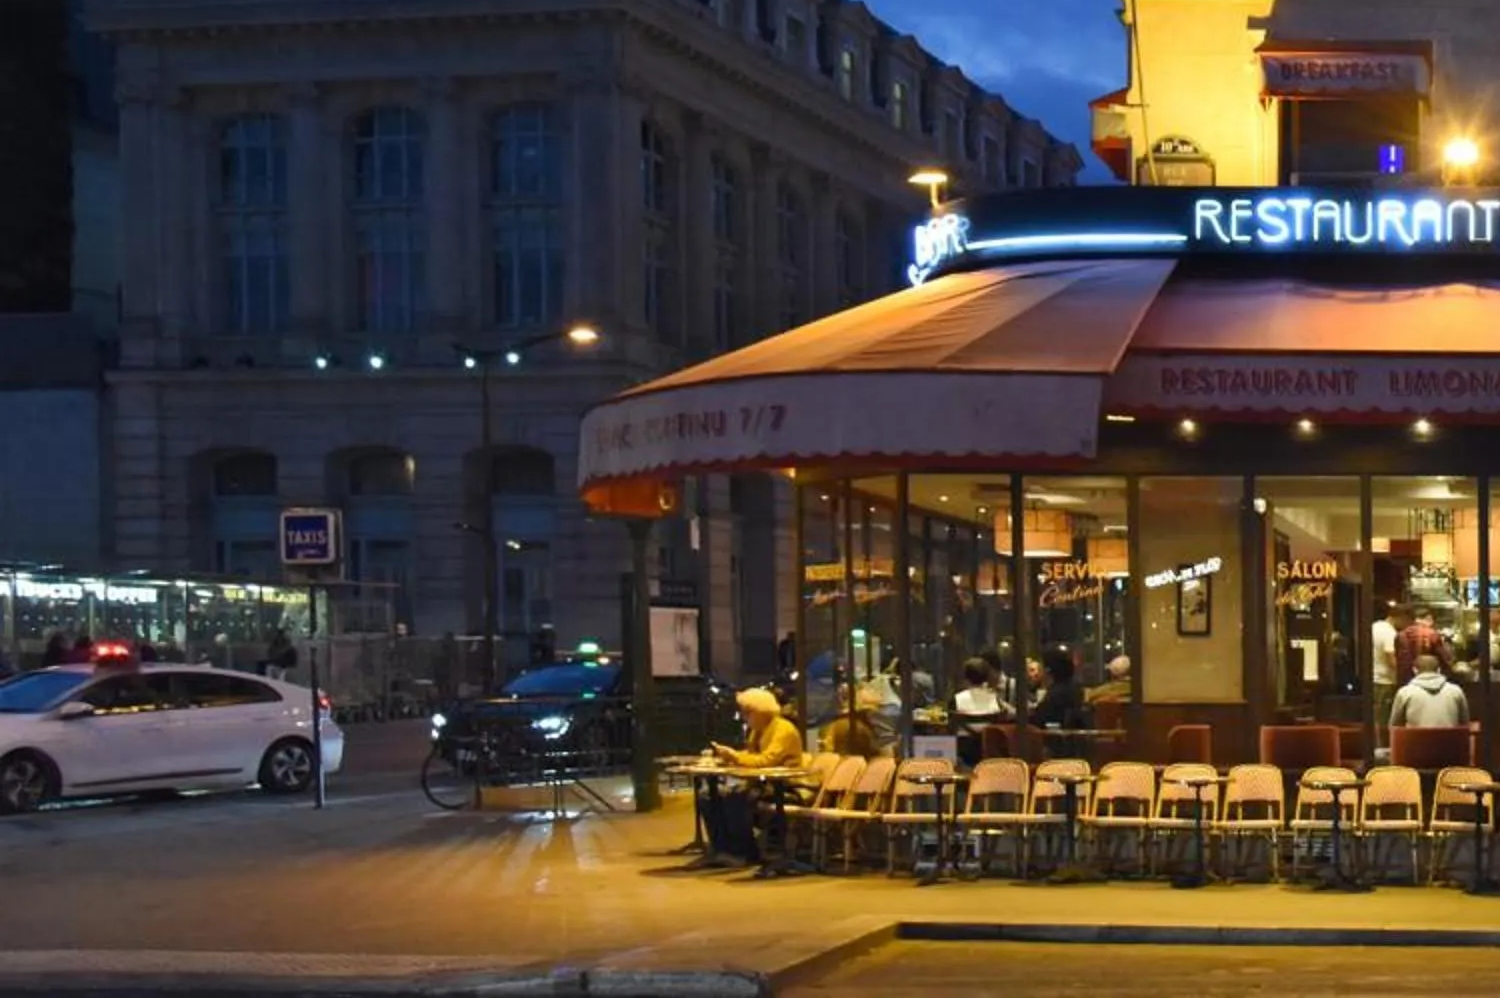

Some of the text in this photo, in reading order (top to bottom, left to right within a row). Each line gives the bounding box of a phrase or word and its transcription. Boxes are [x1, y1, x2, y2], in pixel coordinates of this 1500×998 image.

[1160, 367, 1359, 396] RESTAURANT
[738, 404, 789, 440] 7/7
[288, 530, 326, 546] TAXIS
[1277, 559, 1338, 579] SALON
